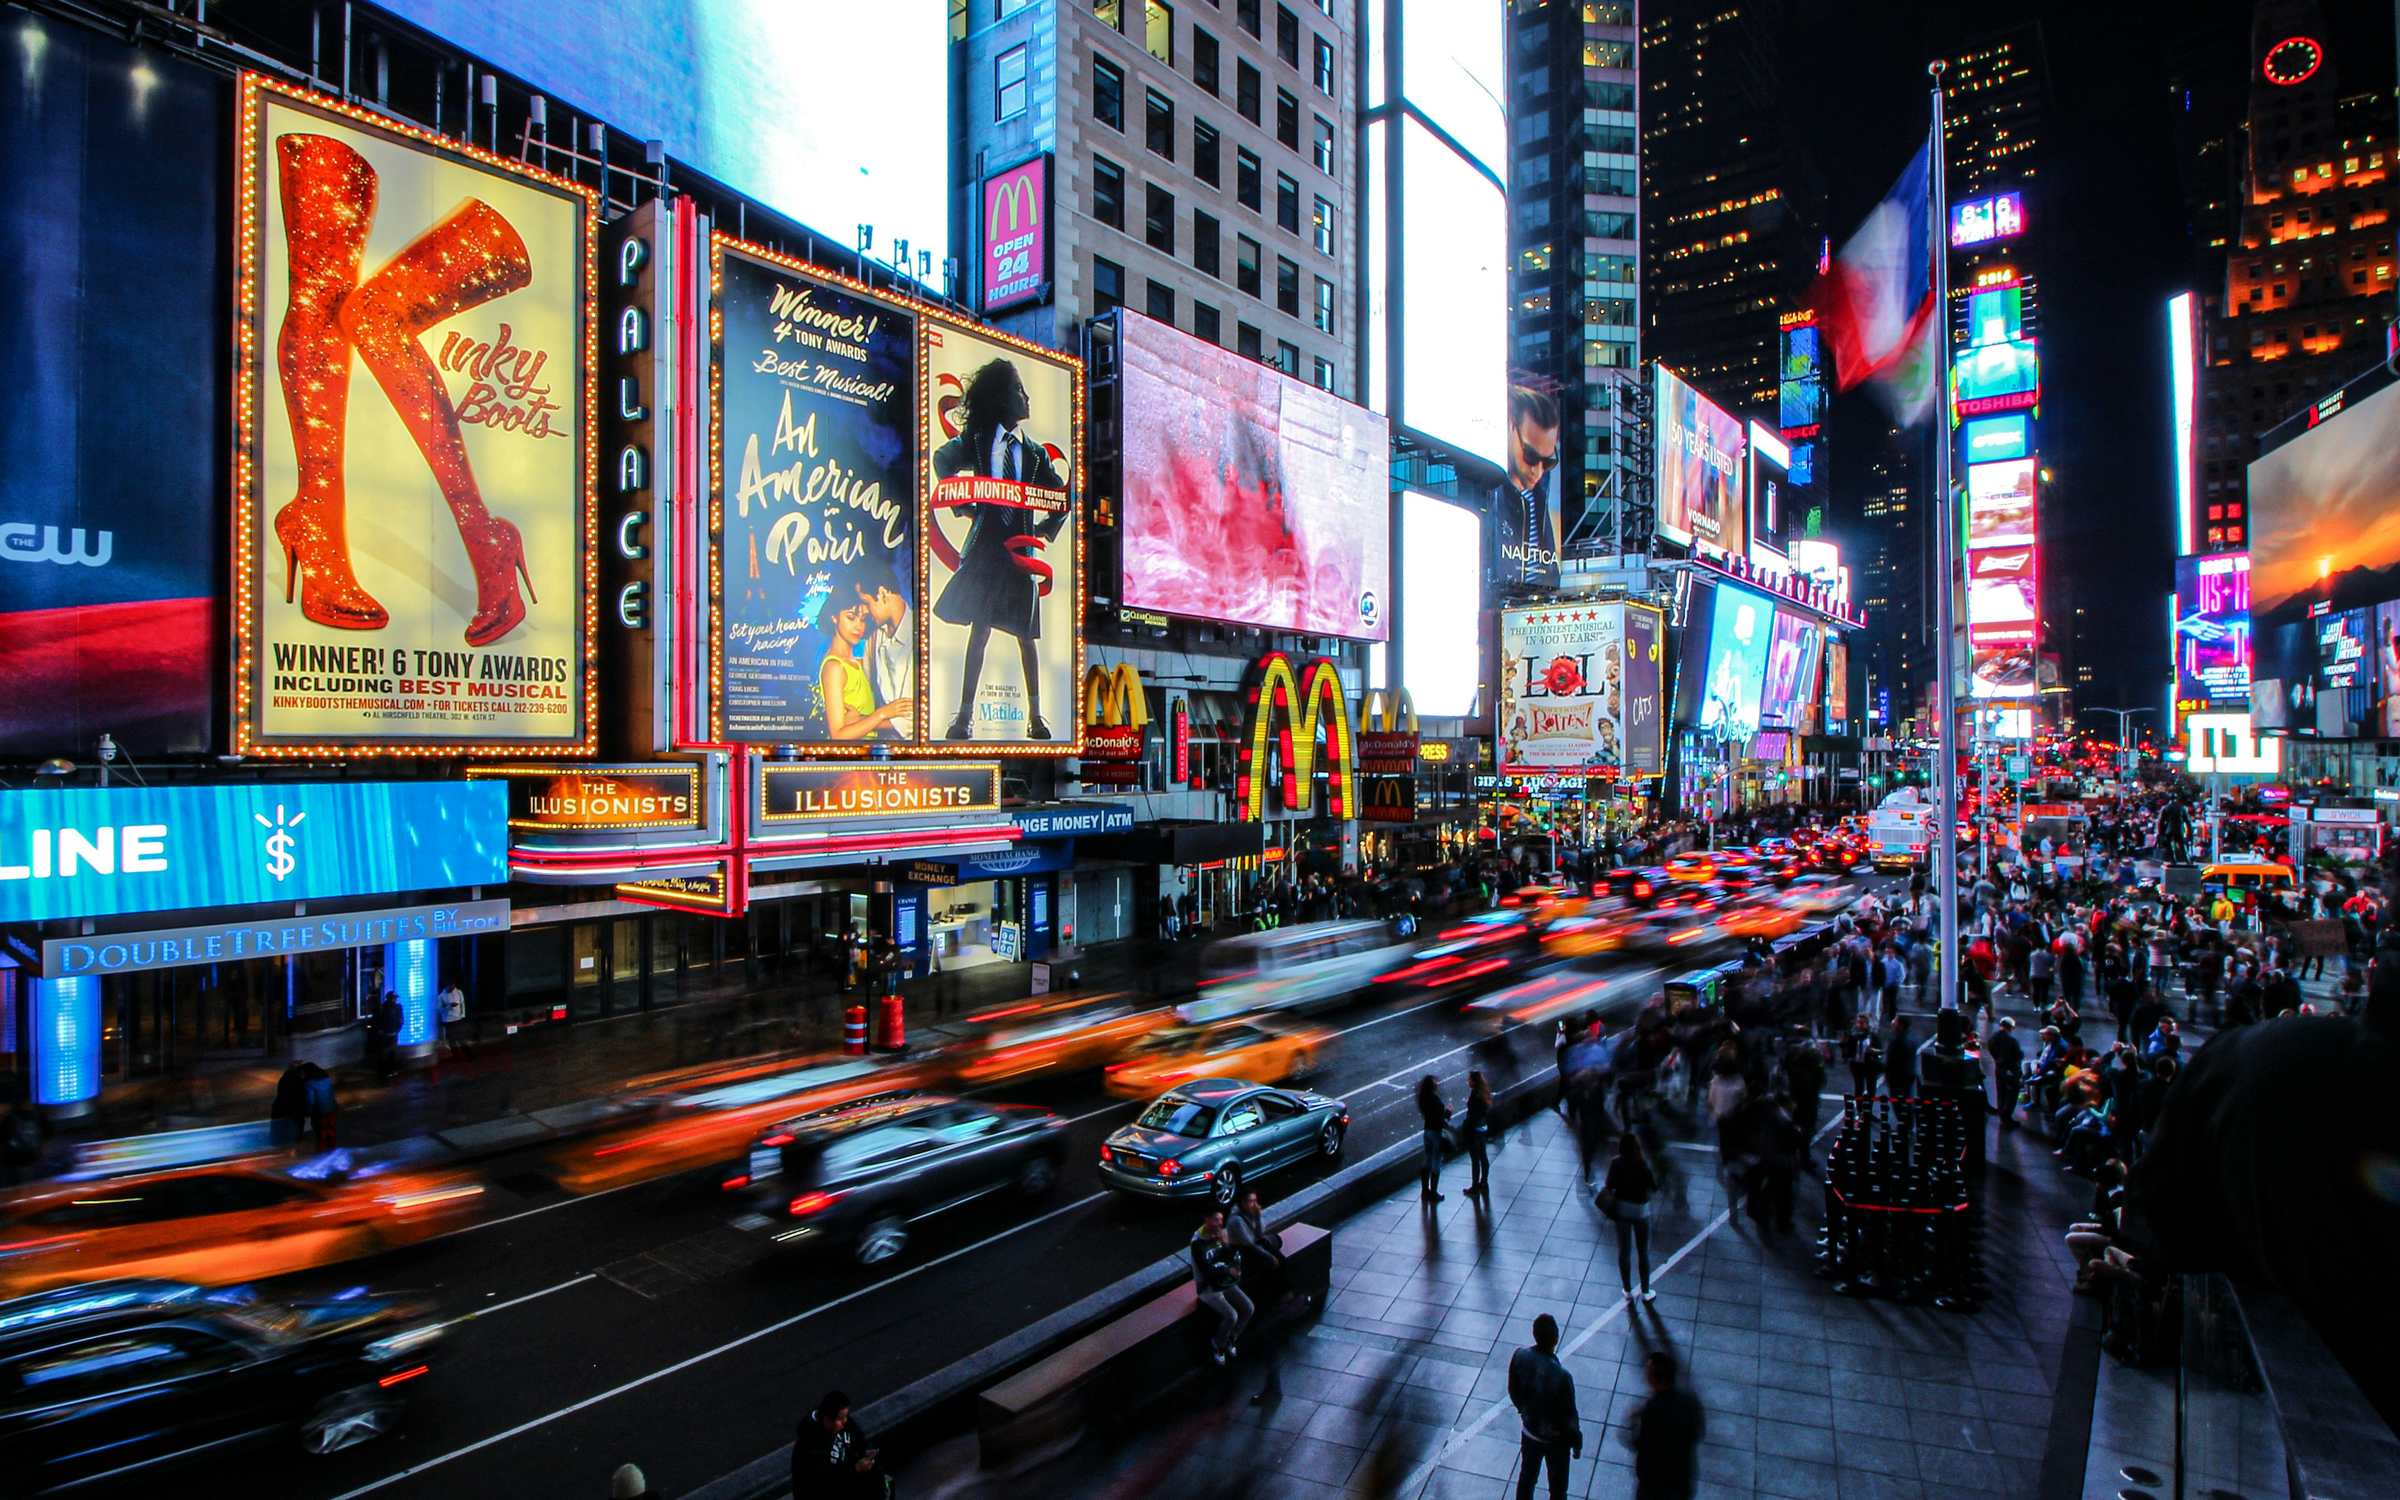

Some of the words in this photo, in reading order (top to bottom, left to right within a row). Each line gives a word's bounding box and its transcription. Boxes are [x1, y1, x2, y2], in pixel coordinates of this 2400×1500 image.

[993, 232, 1034, 258] OPEN
[998, 251, 1029, 282] 24
[989, 274, 1039, 302] HOURS
[769, 284, 878, 343] Winner!
[773, 321, 793, 343] 4
[795, 329, 823, 349] TONY
[825, 339, 868, 362] AWARDS
[752, 350, 811, 380] Best
[812, 364, 895, 403] Musical!
[454, 382, 568, 438] Boots
[1959, 391, 2036, 415] TOSHIBA
[620, 237, 649, 630] PALACE
[772, 389, 818, 458] An
[1684, 427, 1710, 463] YEARS
[1710, 447, 1733, 476] LISTED
[736, 433, 905, 549] American
[938, 481, 971, 501] FINAL
[974, 481, 1022, 503] MONTHS
[1024, 486, 1038, 497] SEE
[1044, 489, 1067, 501] BEFORE
[824, 502, 840, 517] in
[1024, 497, 1061, 510] JANUARY
[1062, 502, 1067, 511] 1
[1687, 507, 1721, 534] VORNADO
[0, 522, 113, 568] CW
[12, 537, 35, 548] THE
[765, 511, 865, 577] Paris
[1501, 543, 1559, 565] NAUTICA
[1528, 624, 1573, 635] FUNNIEST
[1574, 622, 1615, 633] MUSICAL
[273, 643, 385, 675] WINNER!
[393, 648, 407, 676] 6
[413, 650, 475, 680] TONY
[480, 653, 568, 683] AWARDS
[273, 675, 393, 693] INCLUDING
[399, 679, 462, 696] BEST
[467, 681, 568, 699] MUSICAL
[273, 695, 425, 711] KINKYBOOTSTHEMUSICAL.COM
[433, 699, 451, 712] FOR
[454, 700, 490, 713] TICKETS
[491, 701, 512, 713] CALL
[514, 702, 568, 714] 212-239-6200
[979, 703, 1025, 721] Matilda
[1632, 696, 1653, 726] CATS
[1711, 692, 1756, 757] Disney
[1361, 740, 1415, 749] McDonald's
[583, 784, 616, 795] THE
[878, 772, 907, 786] THE
[1474, 775, 1512, 788] GIFS
[1522, 776, 1587, 789] LUAGE
[530, 796, 687, 816] ILLUSIONISTS
[795, 786, 971, 812] ILLUSIONISTS
[1052, 814, 1099, 831] MONEY
[1106, 813, 1132, 827] ATM
[913, 861, 946, 872] MONEY
[970, 851, 997, 861] MONEY
[999, 849, 1040, 859] EXCHANGE
[908, 871, 957, 884] EXCHANGE
[433, 908, 458, 922] BY
[434, 917, 500, 934] HILTON
